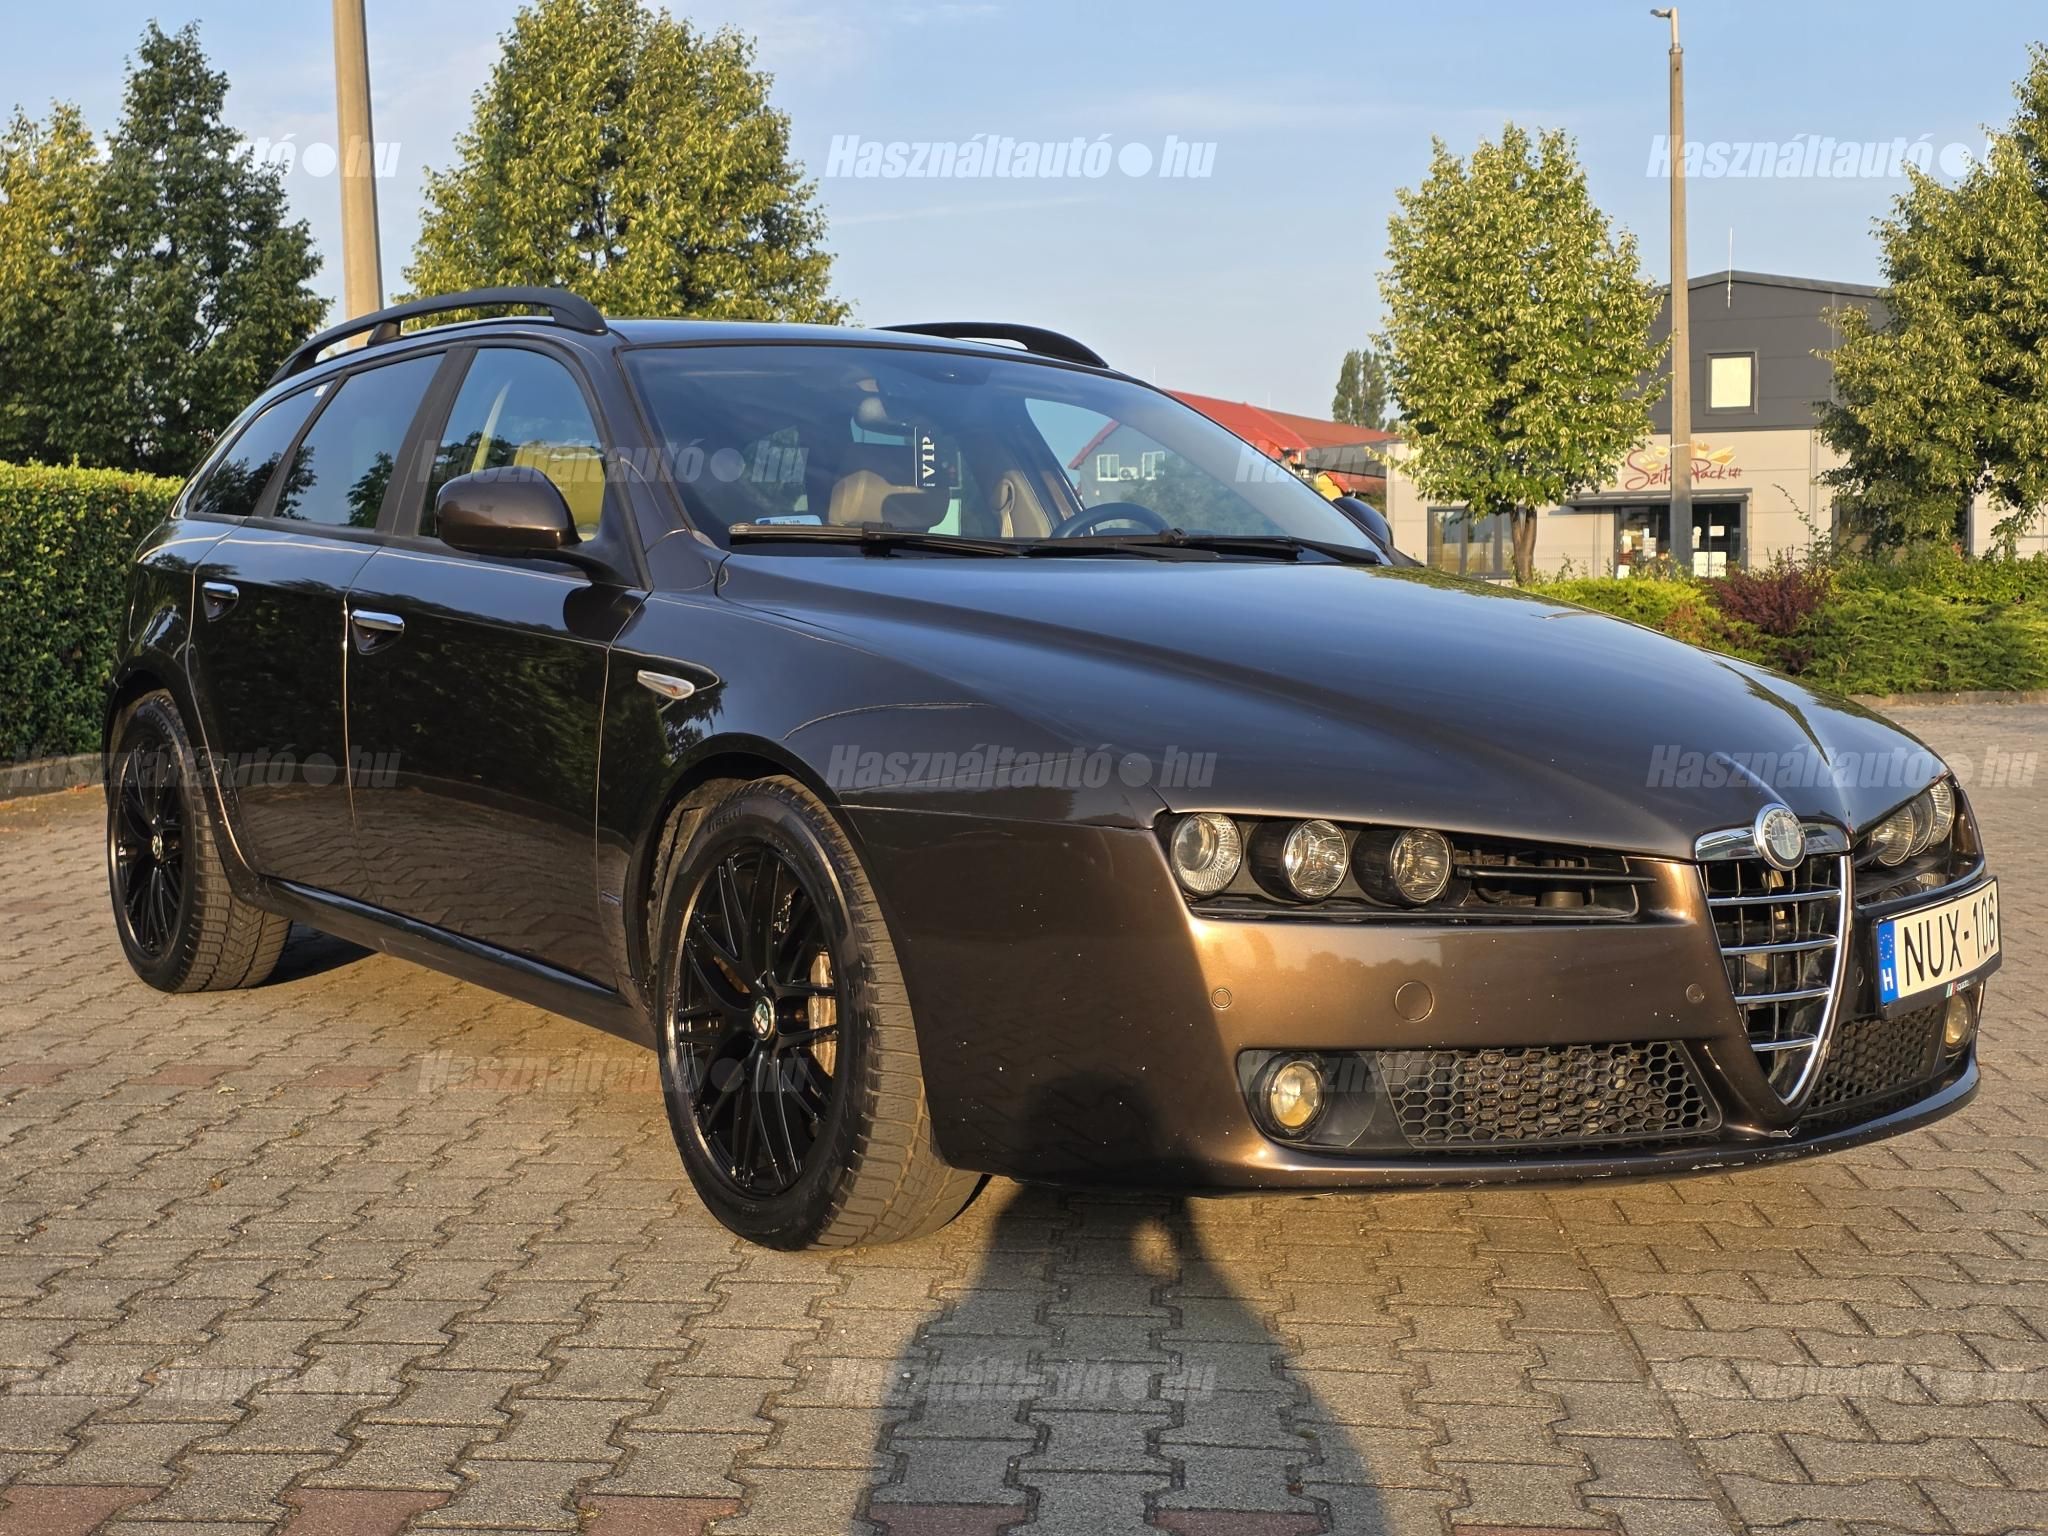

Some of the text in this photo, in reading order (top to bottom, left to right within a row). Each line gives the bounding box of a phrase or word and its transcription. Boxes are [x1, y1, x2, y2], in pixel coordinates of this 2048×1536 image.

[1625, 448, 1672, 490] Szit
[1903, 891, 1996, 987] NUX-106
[1882, 967, 1894, 991] H
